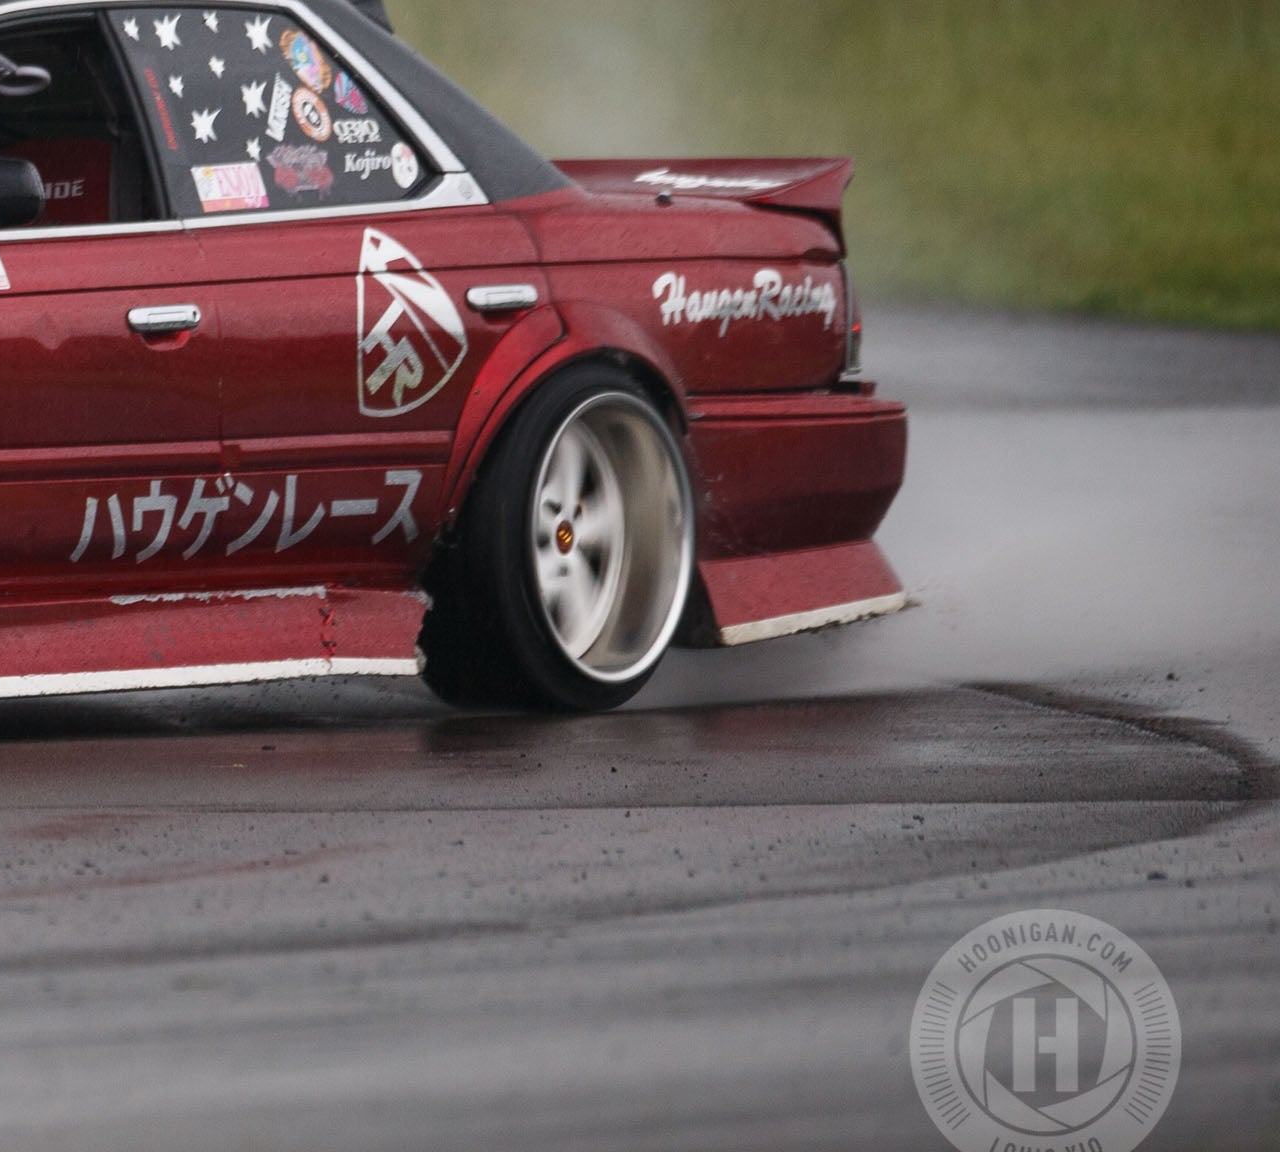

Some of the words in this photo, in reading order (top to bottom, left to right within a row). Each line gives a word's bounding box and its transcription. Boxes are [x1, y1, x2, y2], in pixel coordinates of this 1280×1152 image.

[343, 150, 391, 180] Kojiro
[44, 178, 86, 200] IDE
[69, 469, 423, 564] ハウゲンレース
